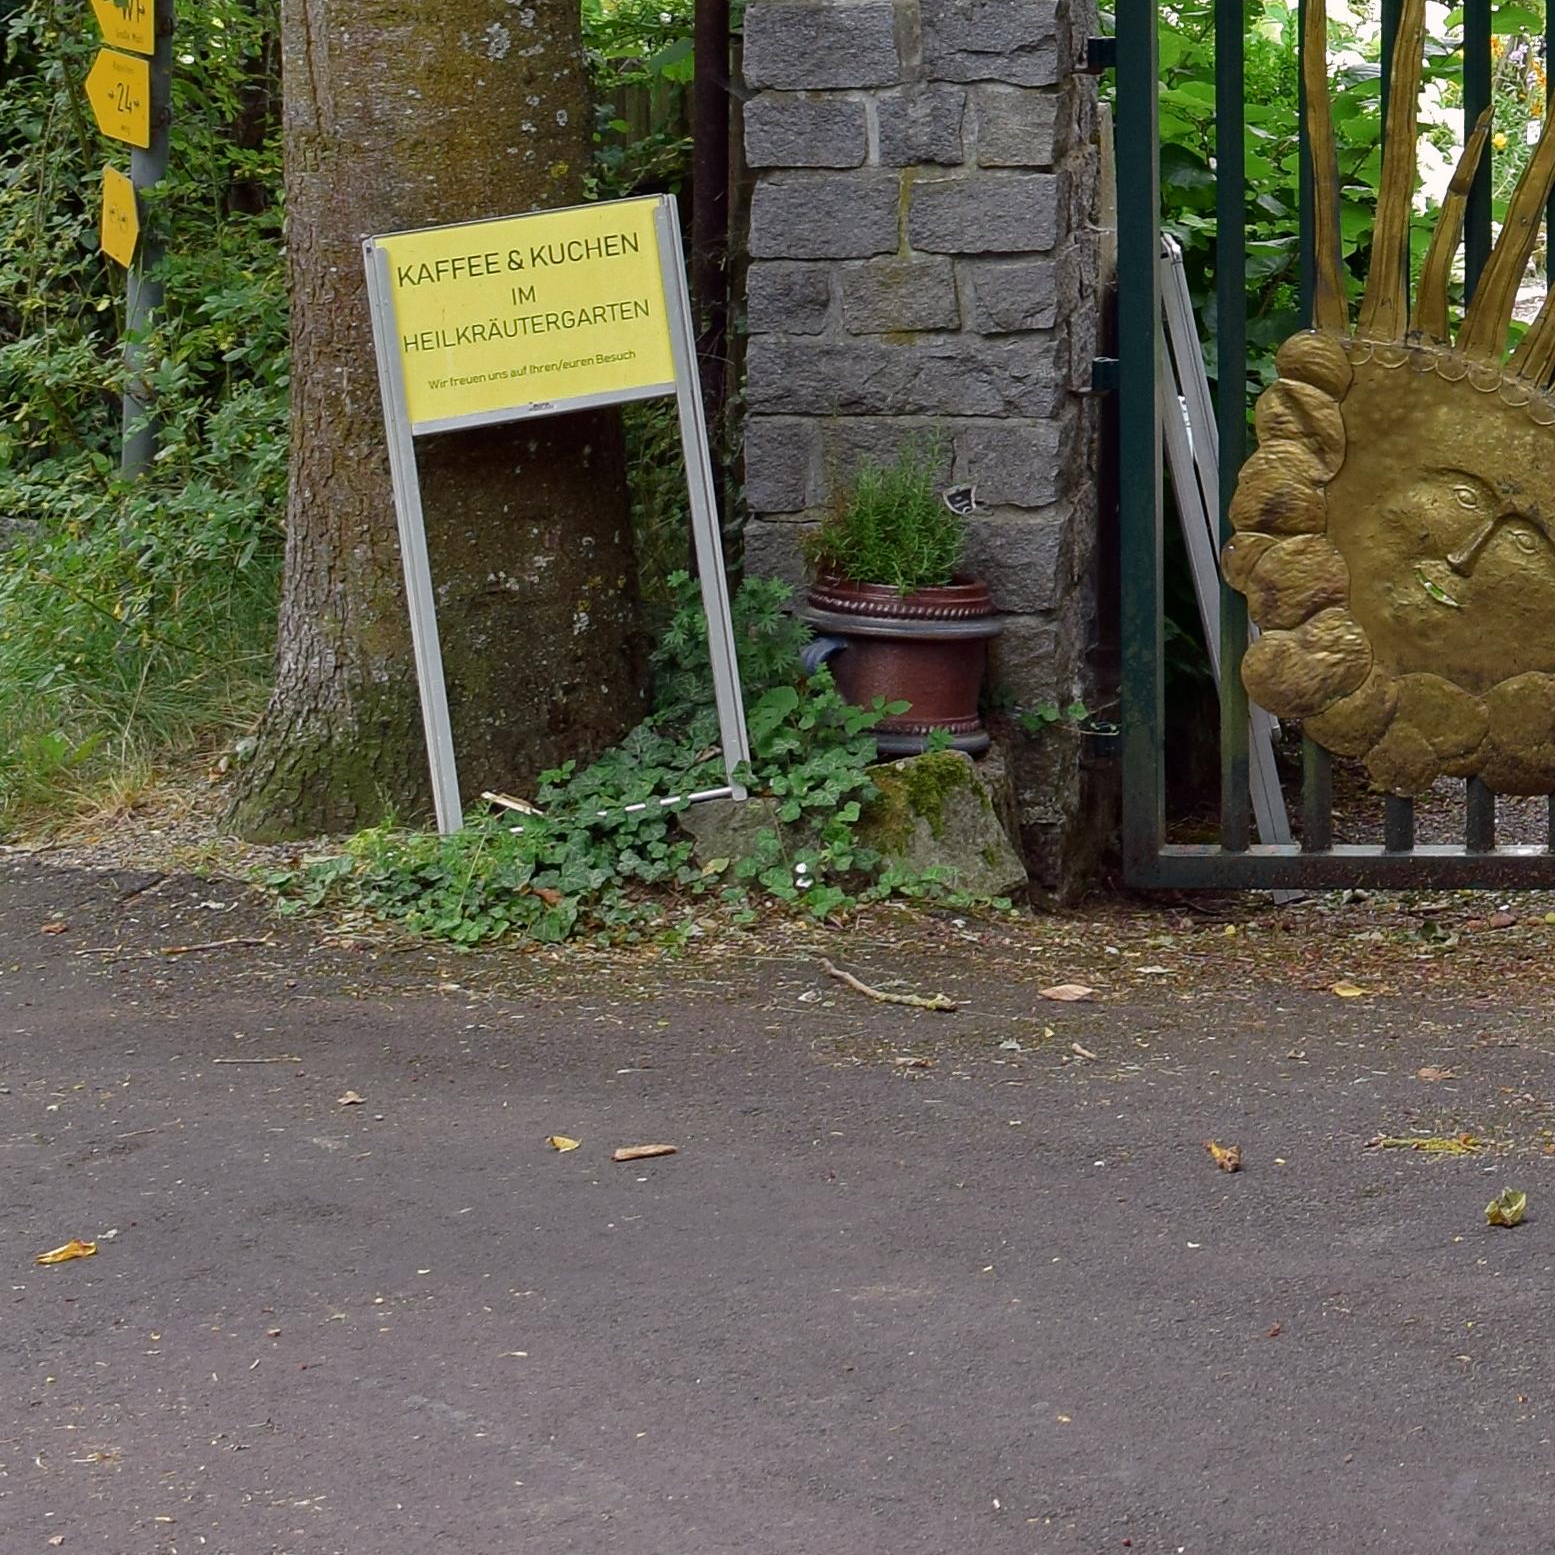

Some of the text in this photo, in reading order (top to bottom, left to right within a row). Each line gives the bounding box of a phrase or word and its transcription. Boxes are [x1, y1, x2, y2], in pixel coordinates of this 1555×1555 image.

[117, 82, 133, 115] 24
[398, 232, 640, 287] KAFFEE & KUCHEN
[512, 285, 536, 306] IM
[403, 299, 650, 353] HEILKRÄUTERGARTEN
[428, 349, 637, 390] Wir freuen uns auf Ihren/euren Besuch
